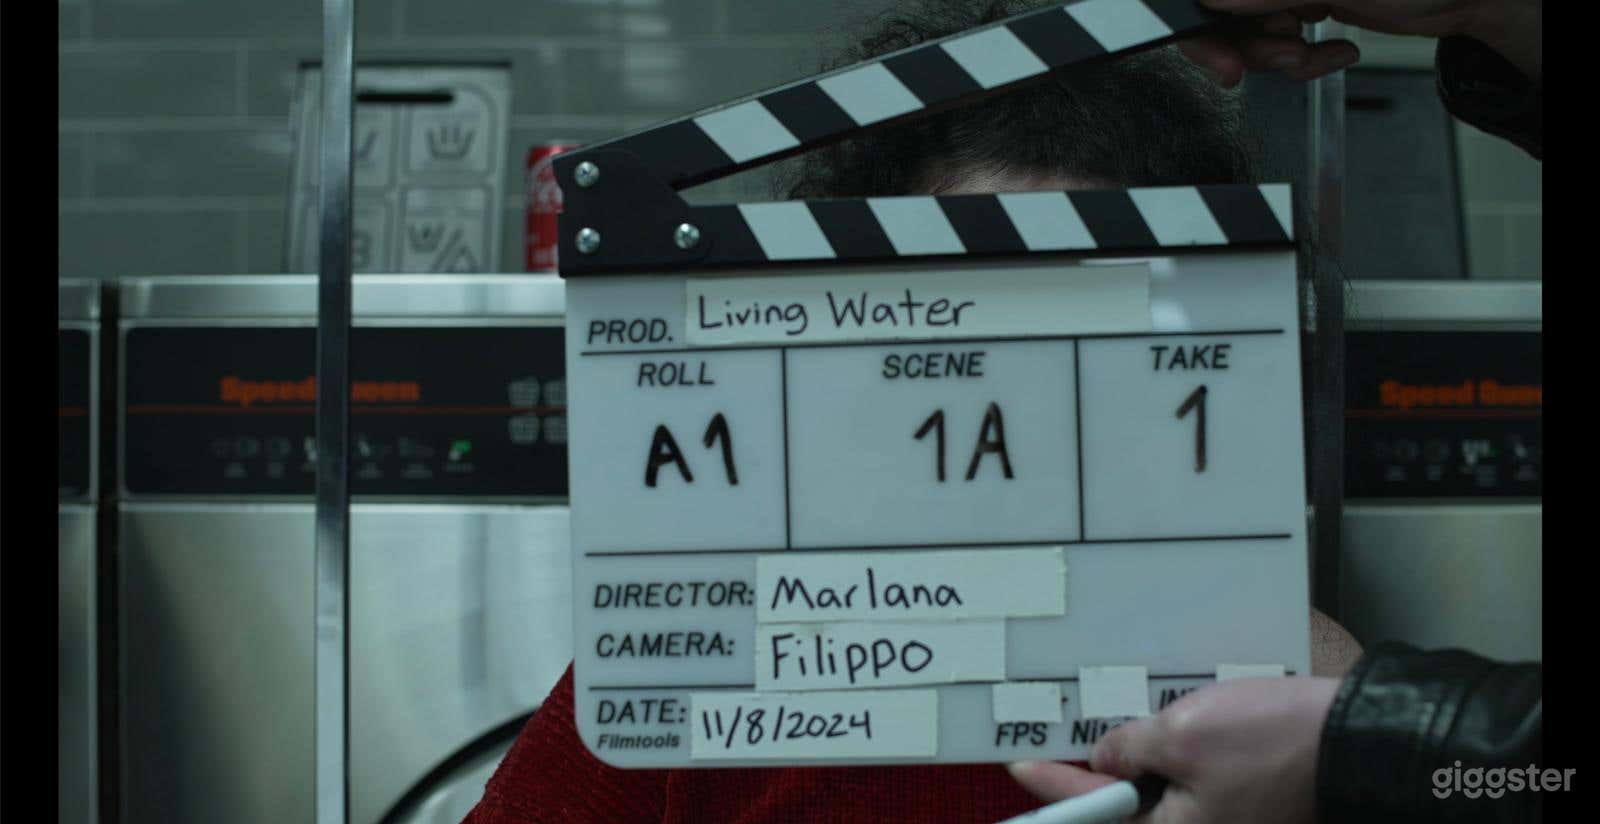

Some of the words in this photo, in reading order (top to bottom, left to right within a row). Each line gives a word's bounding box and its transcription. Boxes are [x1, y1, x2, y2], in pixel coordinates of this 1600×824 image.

[699, 295, 808, 335] Living
[826, 288, 975, 328] Water
[587, 318, 673, 345] PROD.
[882, 350, 986, 380] SCENE
[1150, 343, 1231, 371] TAKE
[637, 362, 715, 387] ROLL
[913, 401, 1015, 483] 1A
[1175, 384, 1208, 474] 1
[645, 411, 739, 488] A1
[593, 580, 755, 609] DIRECTOR:
[771, 567, 963, 611] Marlana
[596, 632, 735, 658] CAMERA:
[771, 632, 933, 684] Filippo
[596, 700, 687, 725] DATE:
[597, 732, 680, 750] Filmtools
[703, 706, 873, 749] 11/8/2024
[995, 721, 1048, 747] FPS
